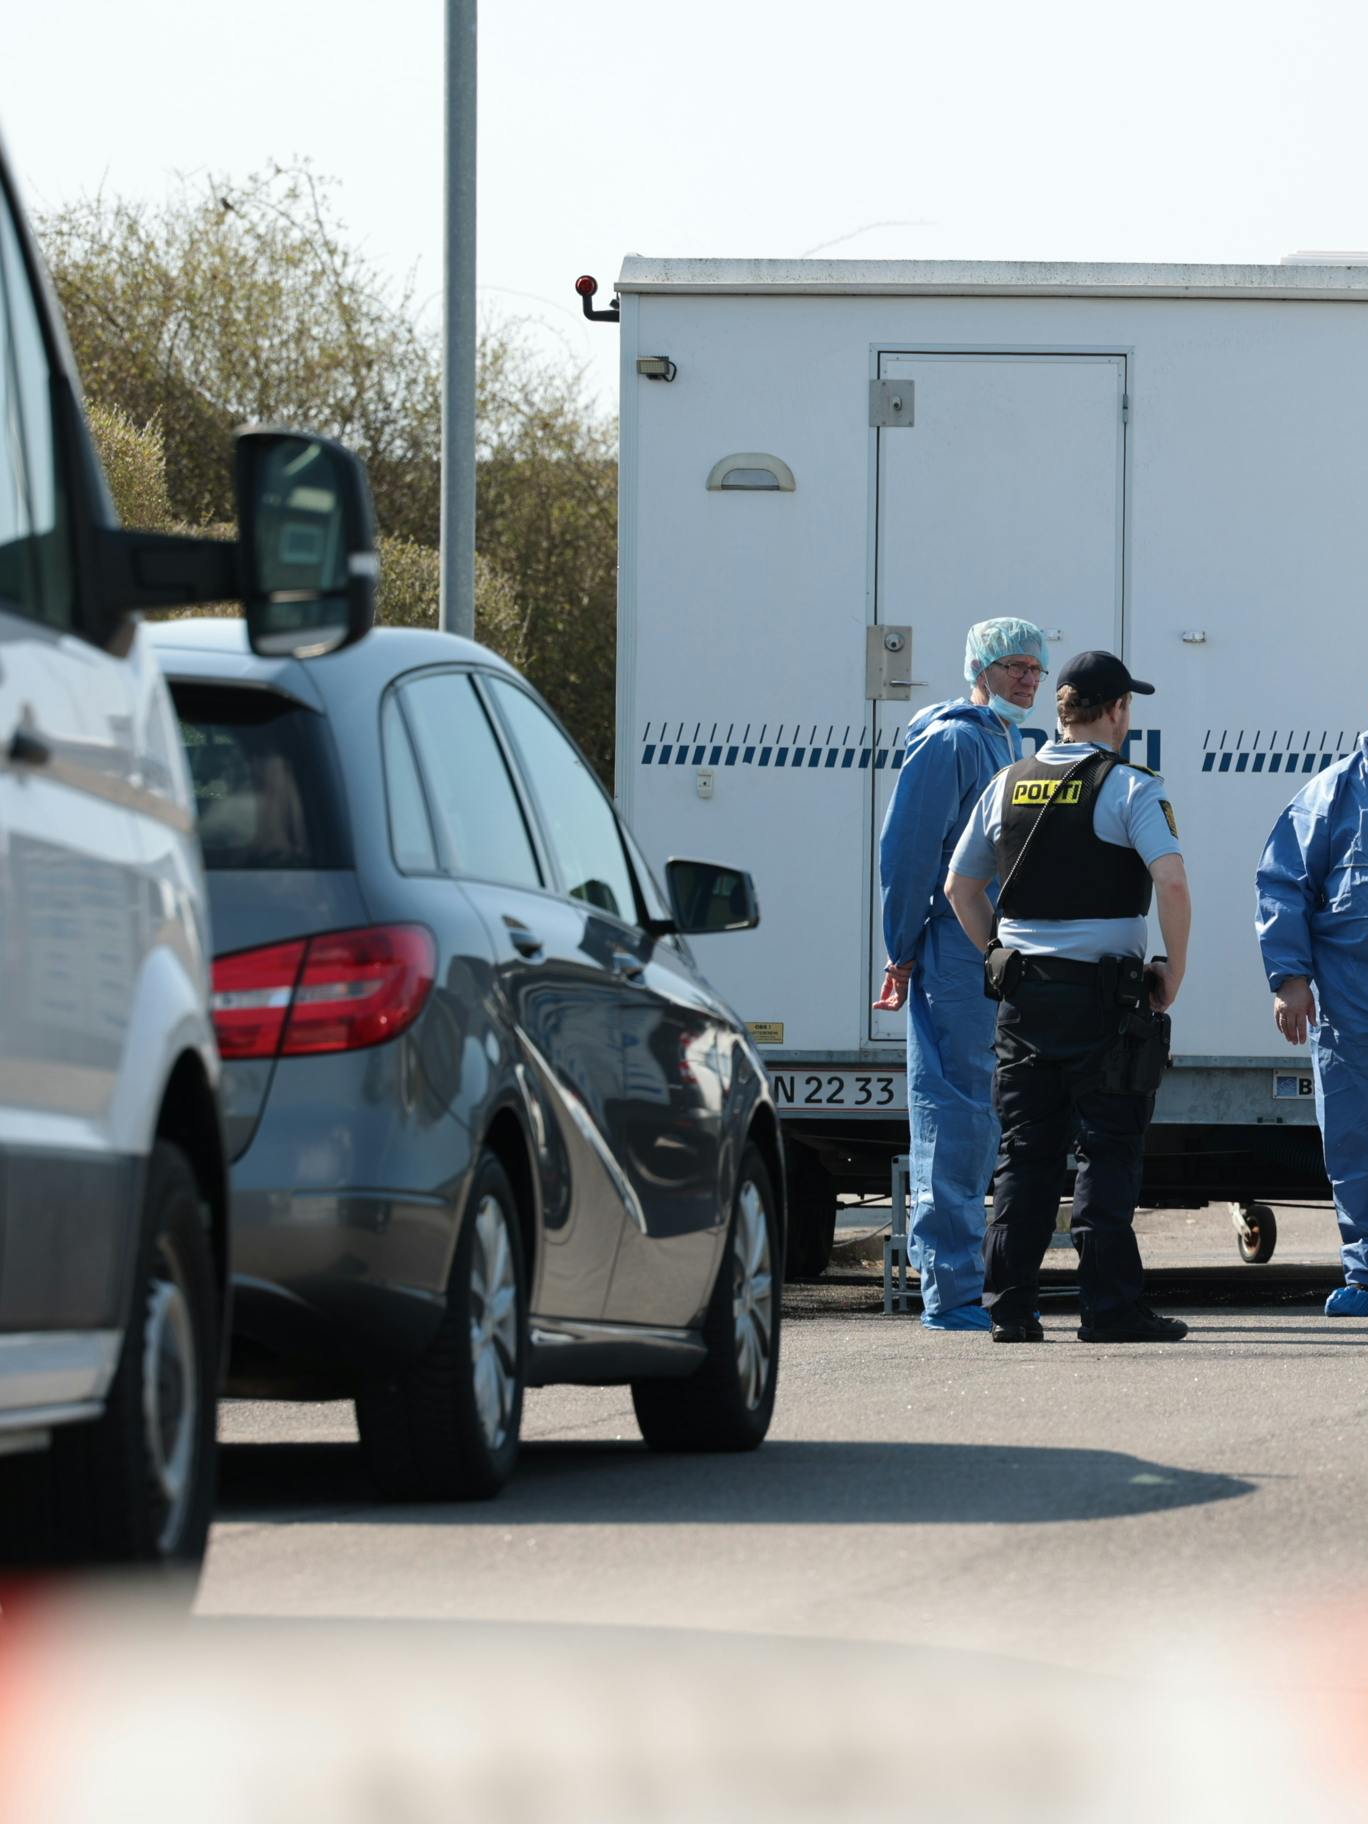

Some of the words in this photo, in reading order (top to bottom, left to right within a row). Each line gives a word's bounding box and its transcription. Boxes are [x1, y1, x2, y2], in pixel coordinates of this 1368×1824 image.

[1014, 783, 1080, 801] POLTI
[773, 1075, 796, 1104] N
[804, 1075, 845, 1105] 22
[854, 1076, 895, 1106] 33
